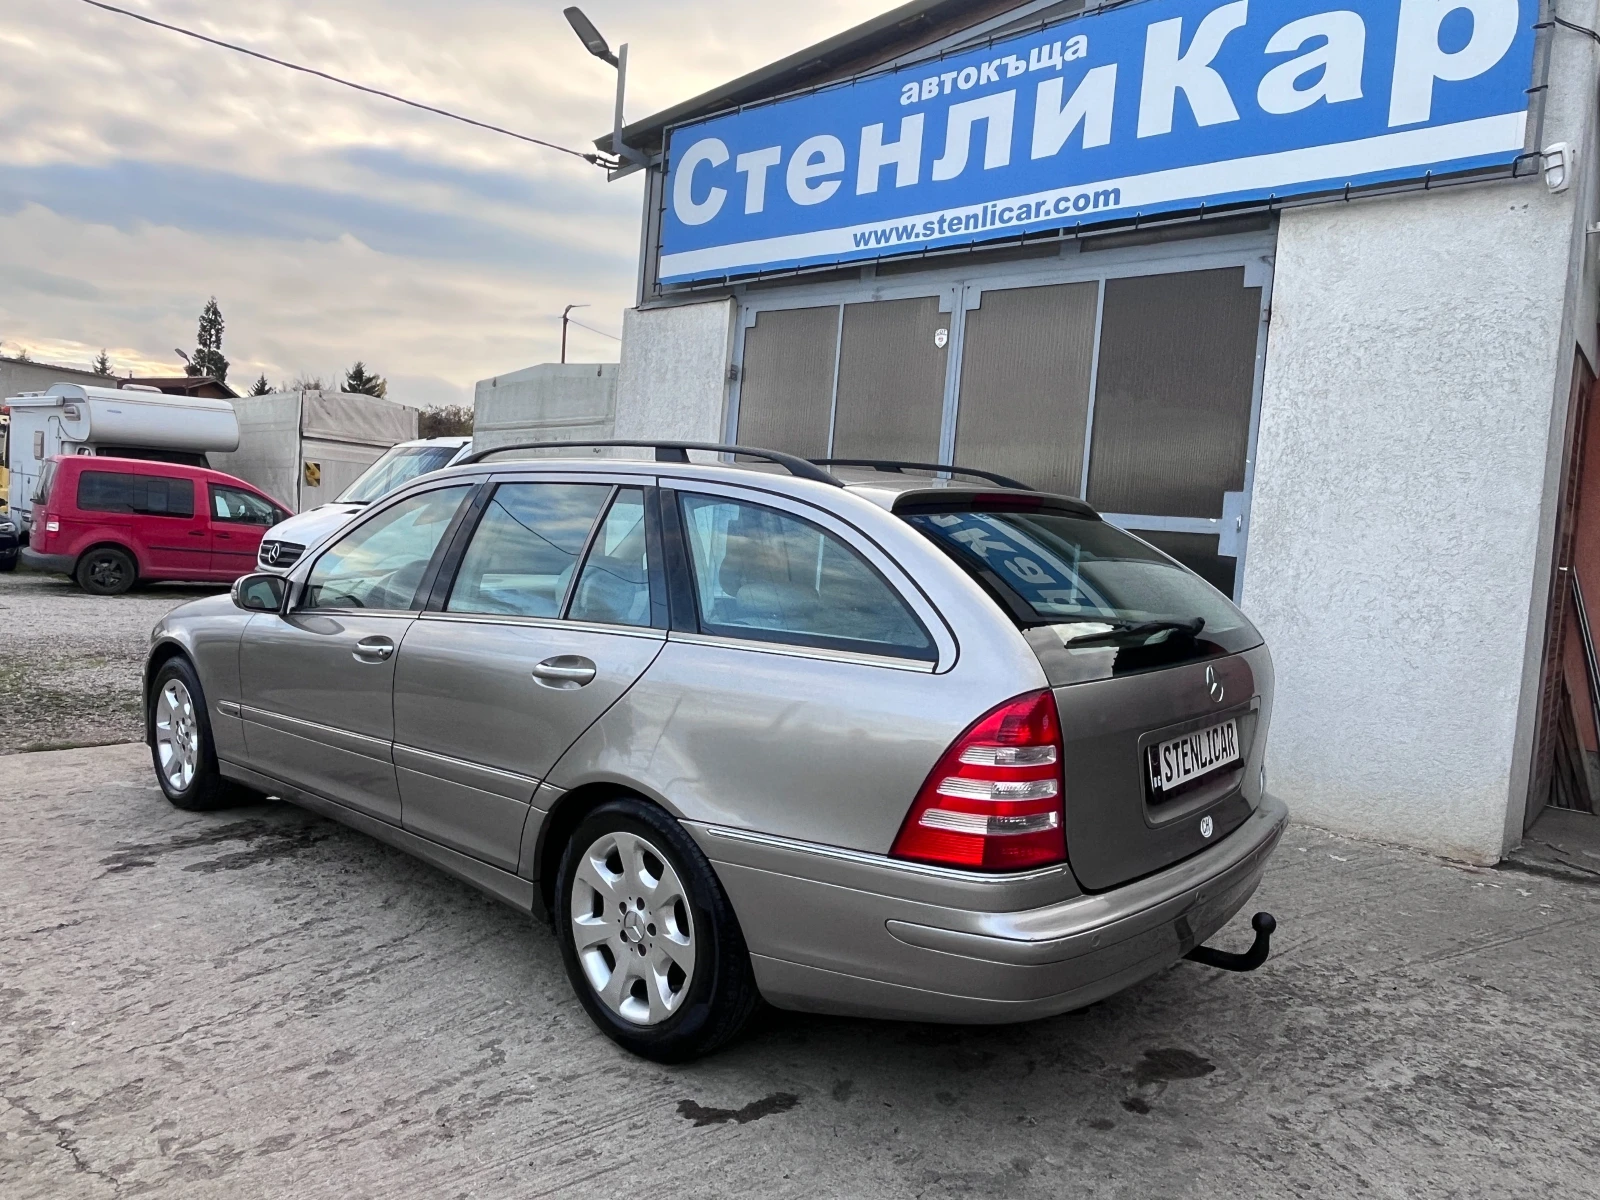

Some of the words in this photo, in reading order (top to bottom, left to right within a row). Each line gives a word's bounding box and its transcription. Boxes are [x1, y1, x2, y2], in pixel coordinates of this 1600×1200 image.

[900, 34, 1088, 106] автокъща
[853, 187, 1121, 247] www.stenlicar.com
[1163, 722, 1236, 783] STENLICAR
